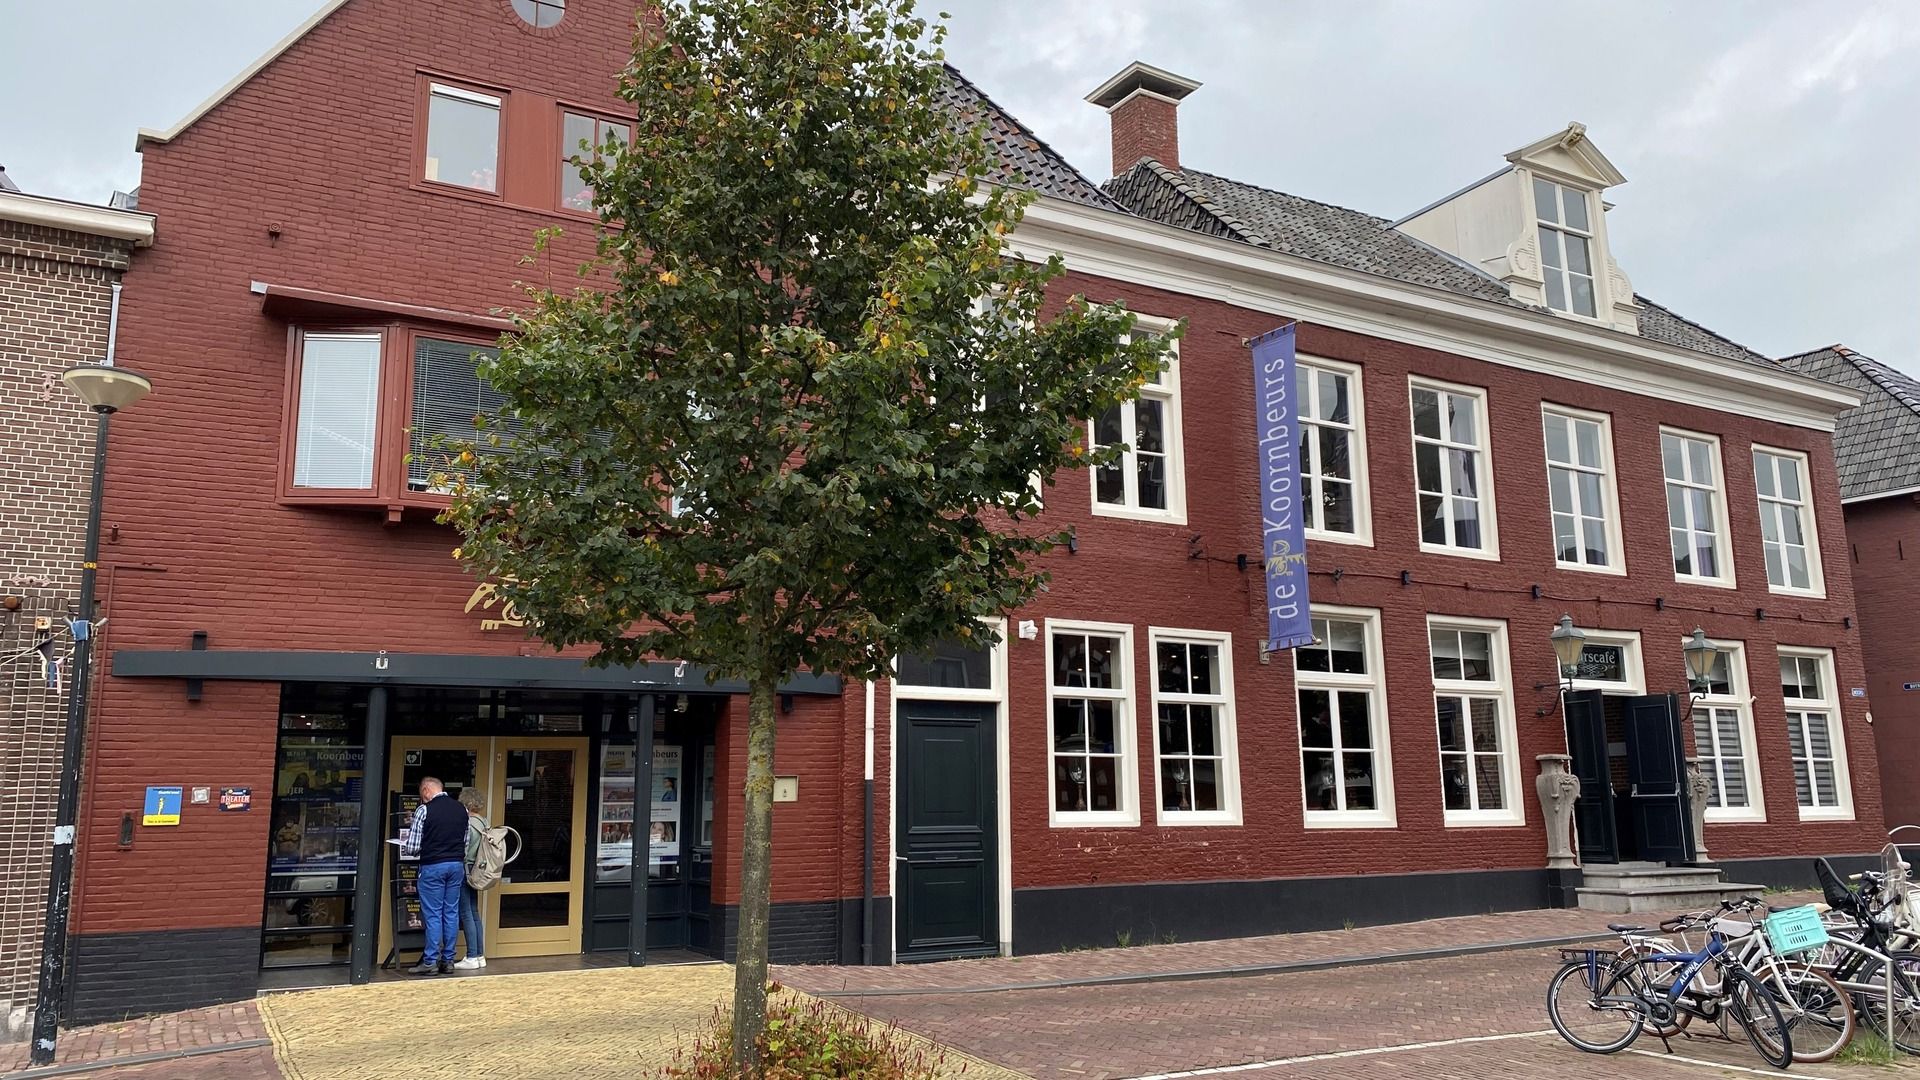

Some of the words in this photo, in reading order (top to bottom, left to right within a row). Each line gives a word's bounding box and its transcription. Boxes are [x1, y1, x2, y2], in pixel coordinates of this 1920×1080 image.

[1260, 358, 1291, 536] Koornbeurs
[1269, 583, 1298, 619] de
[1583, 651, 1616, 664] rscafé
[317, 750, 363, 760] Koornbeu
[220, 795, 250, 803] THEATER
[1680, 961, 1699, 985] ALPINA
